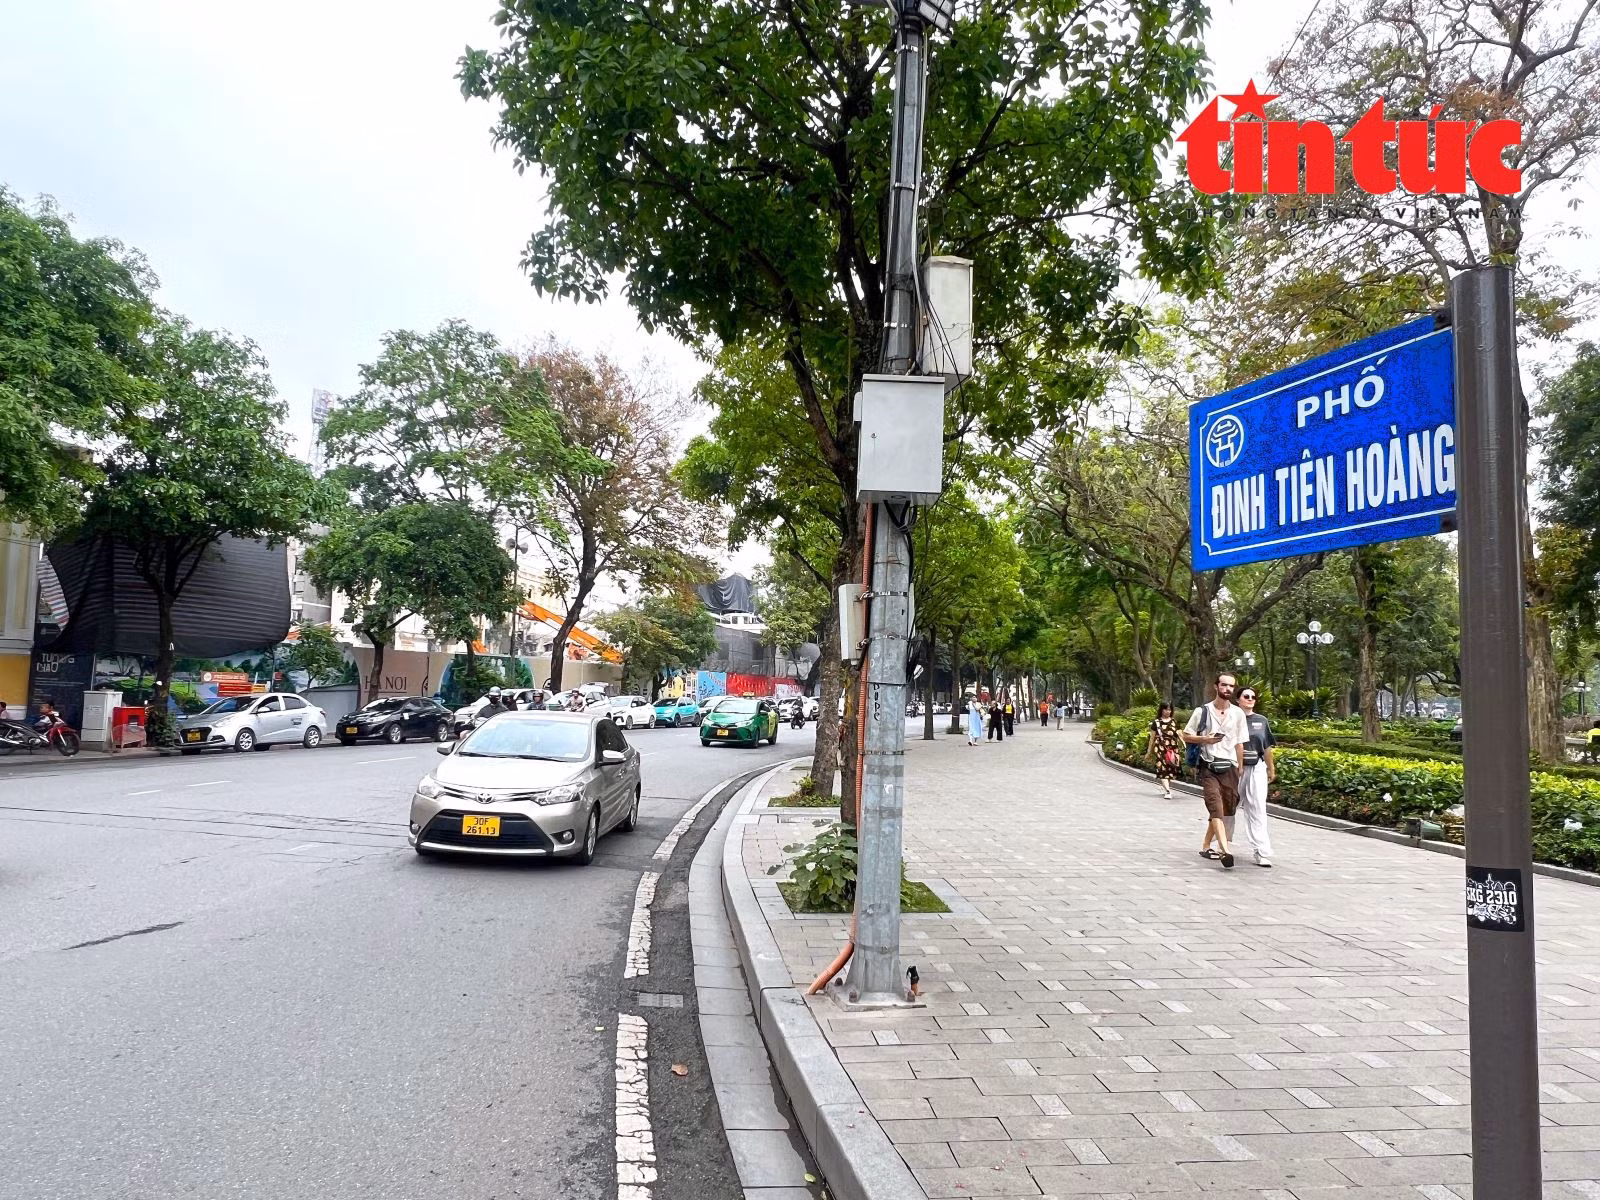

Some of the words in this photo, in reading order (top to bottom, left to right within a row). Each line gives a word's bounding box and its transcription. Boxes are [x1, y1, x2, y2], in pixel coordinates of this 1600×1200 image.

[1297, 355, 1388, 428] PHỐ
[1211, 473, 1266, 539] ĐINH
[1275, 448, 1335, 526] TIÊN
[1346, 423, 1456, 513] HOÀNG
[466, 825, 496, 835] 261.13
[474, 817, 490, 826] 30F
[1486, 889, 1518, 906] 2310
